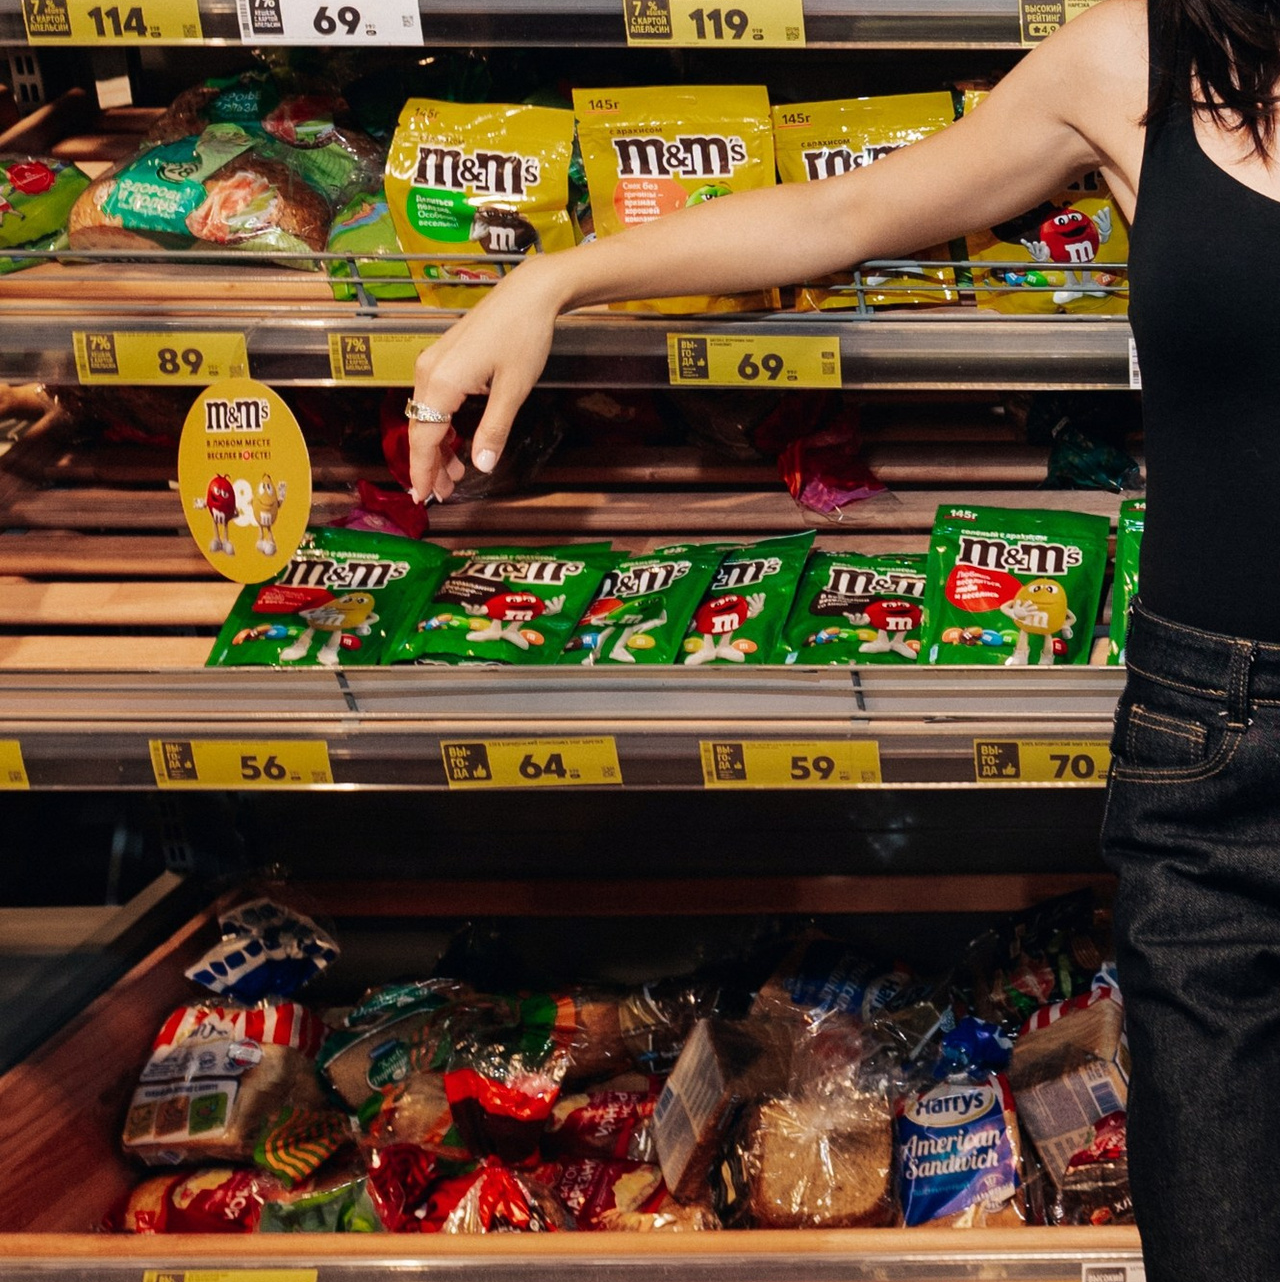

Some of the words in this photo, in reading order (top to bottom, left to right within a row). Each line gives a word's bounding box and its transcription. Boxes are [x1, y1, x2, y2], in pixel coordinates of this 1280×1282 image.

[87, 6, 148, 38] 114
[313, 6, 361, 36] 69
[638, 16, 667, 25] КАРТОЙ
[1025, 4, 1062, 13] ВЫСОКИЙ
[1027, 14, 1061, 22] РЕЙТИНГ
[631, 26, 670, 34] АПЕЛЬСИН
[688, 8, 749, 40] 119
[589, 100, 621, 111] 145г
[782, 113, 811, 125] 145г
[617, 126, 662, 135] арахисом
[412, 142, 541, 194] m&m's
[612, 135, 749, 179] m&m's
[157, 348, 204, 376] 89
[737, 353, 784, 380] 69
[955, 535, 1082, 575] m&m's
[240, 755, 286, 780] 56
[518, 753, 567, 780] 64
[790, 755, 834, 780] 59
[982, 766, 998, 776] ДА
[1050, 754, 1095, 779] 70
[915, 1089, 985, 1117] Harrys
[902, 1128, 1001, 1159] American
[904, 1149, 998, 1180] Sandwich
